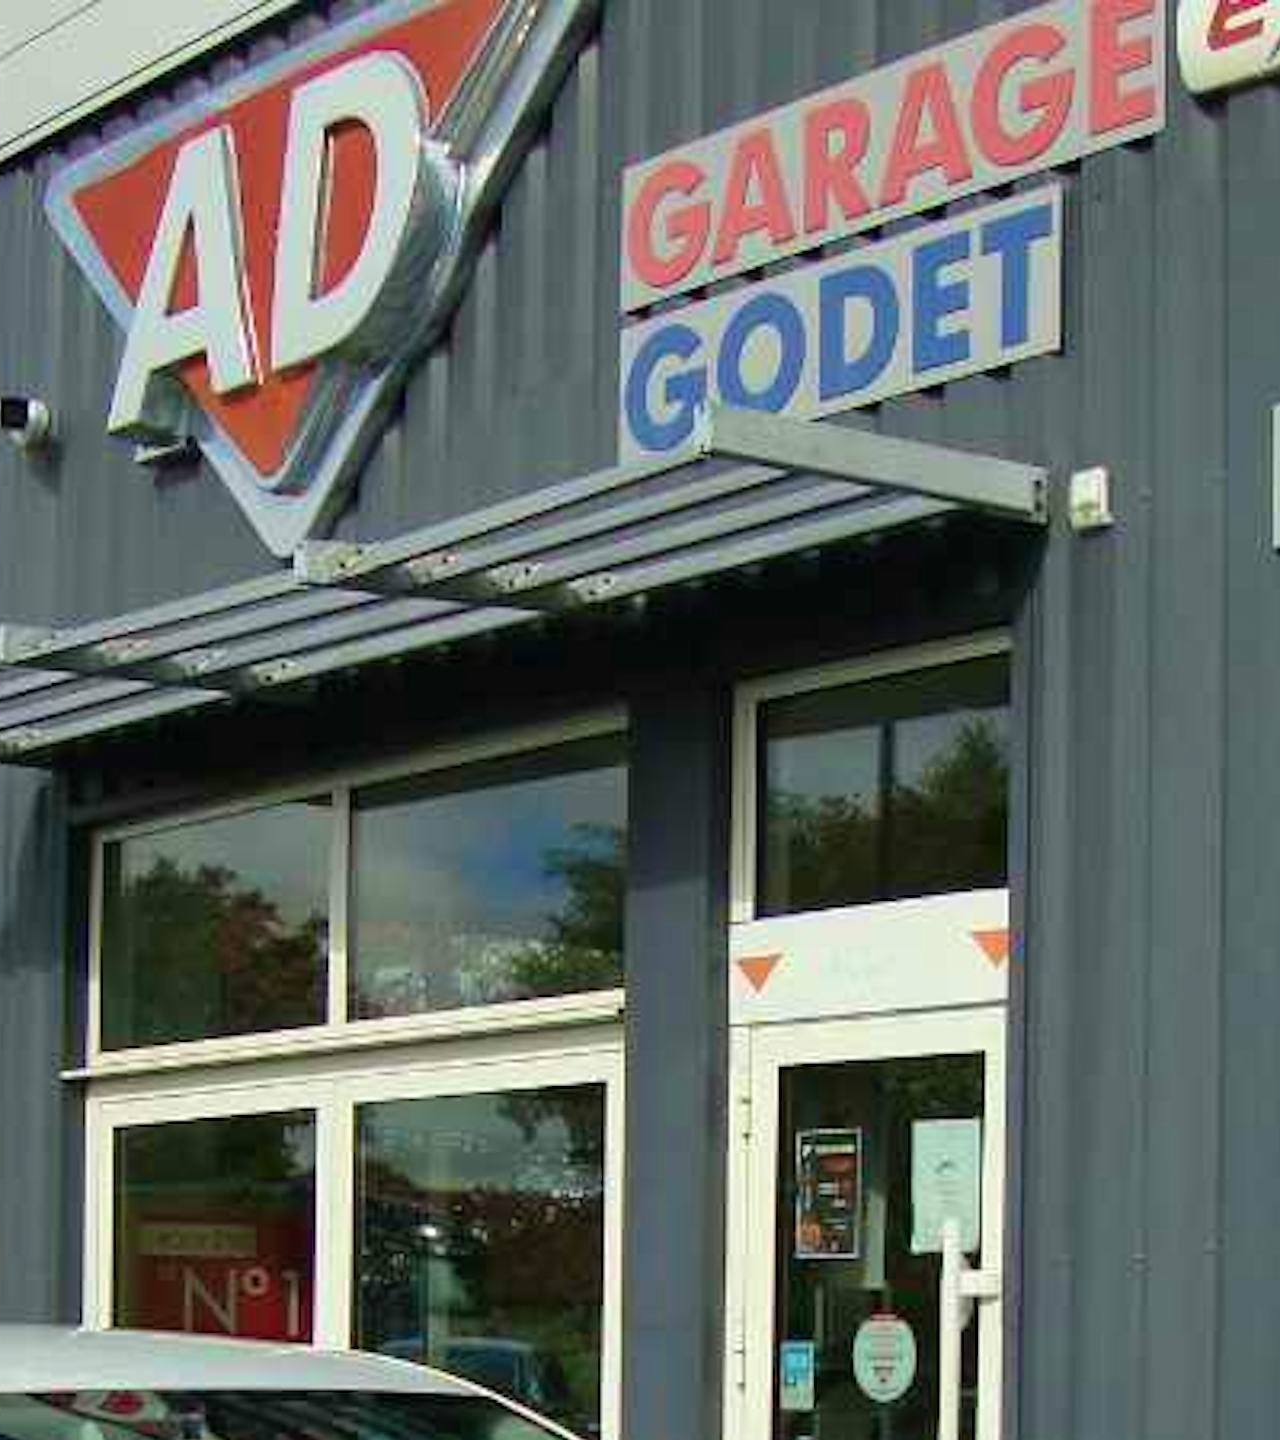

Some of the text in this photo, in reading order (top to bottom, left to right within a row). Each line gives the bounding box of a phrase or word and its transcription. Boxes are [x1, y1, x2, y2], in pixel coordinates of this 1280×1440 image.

[107, 48, 430, 436] AD
[626, 0, 1156, 290] GARAGE
[625, 204, 1054, 453] GODET
